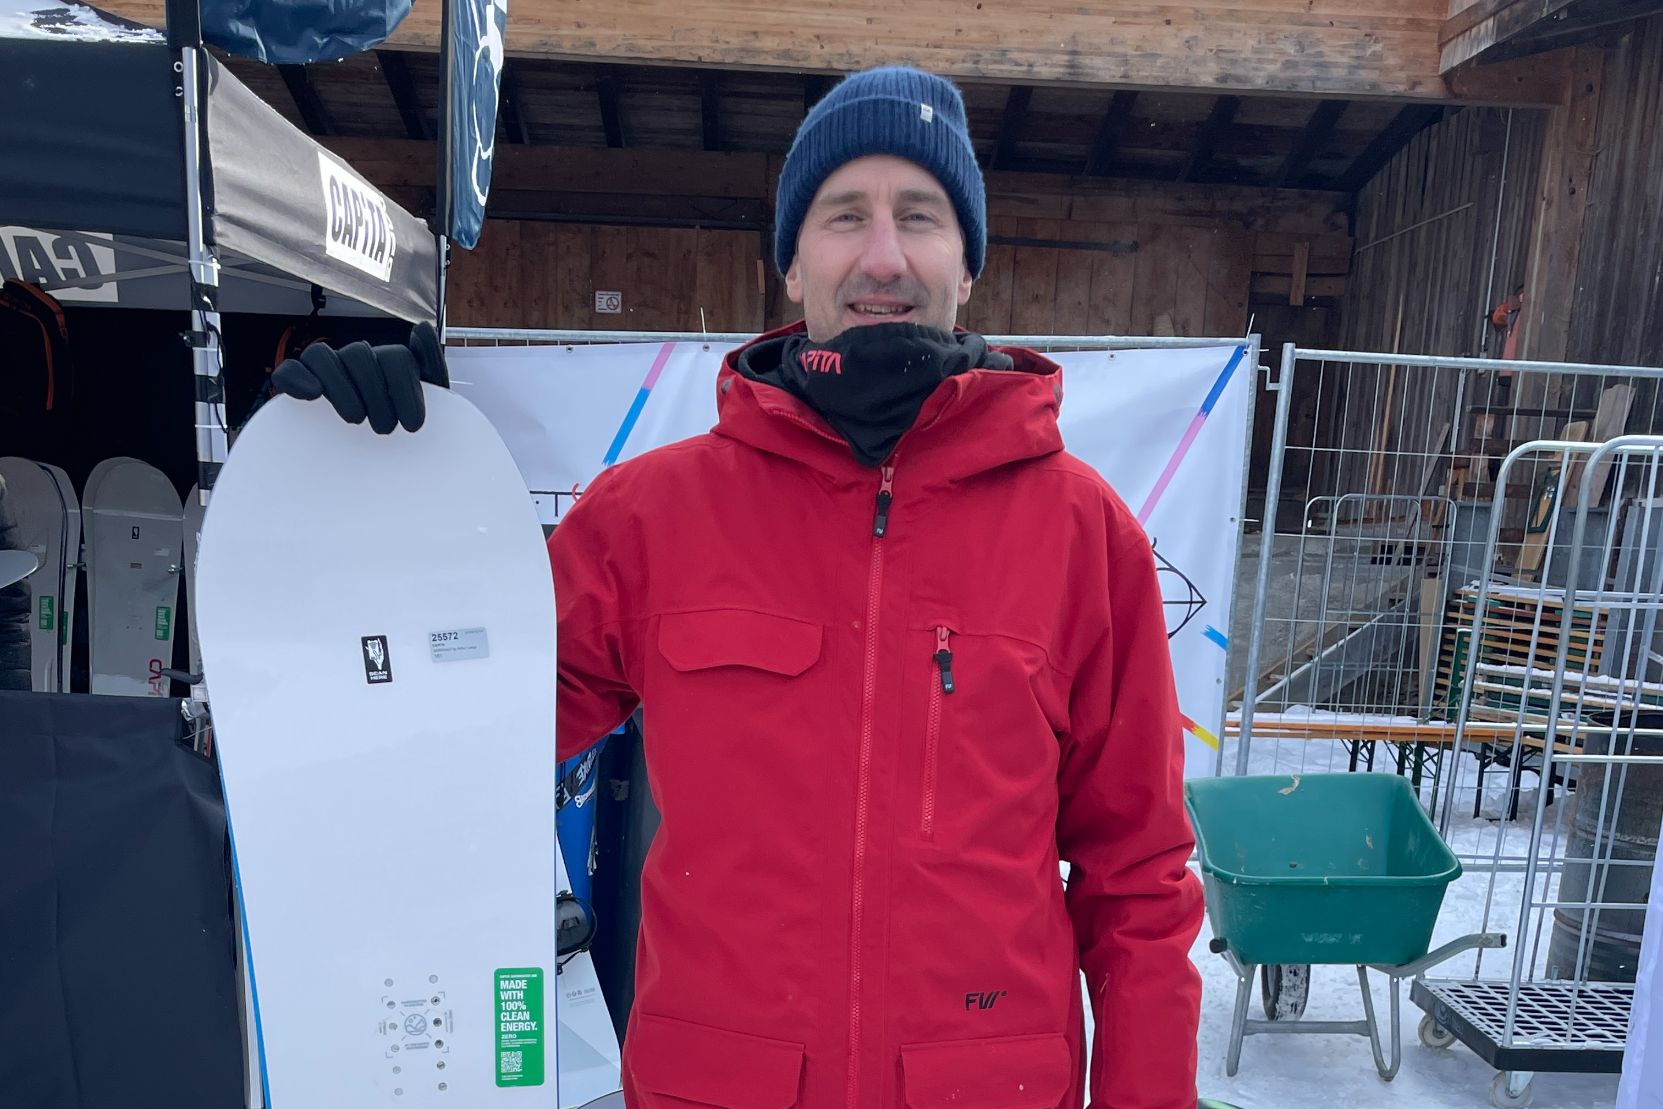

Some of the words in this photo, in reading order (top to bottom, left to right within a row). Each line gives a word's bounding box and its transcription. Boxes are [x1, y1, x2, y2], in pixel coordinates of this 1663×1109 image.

[431, 632, 459, 642] 25572
[500, 979, 527, 989] MADE
[500, 990, 524, 1000] WITH
[500, 1001, 527, 1011] 100%
[500, 1011, 530, 1021] CLEAN
[501, 1021, 538, 1031] ENERGY.
